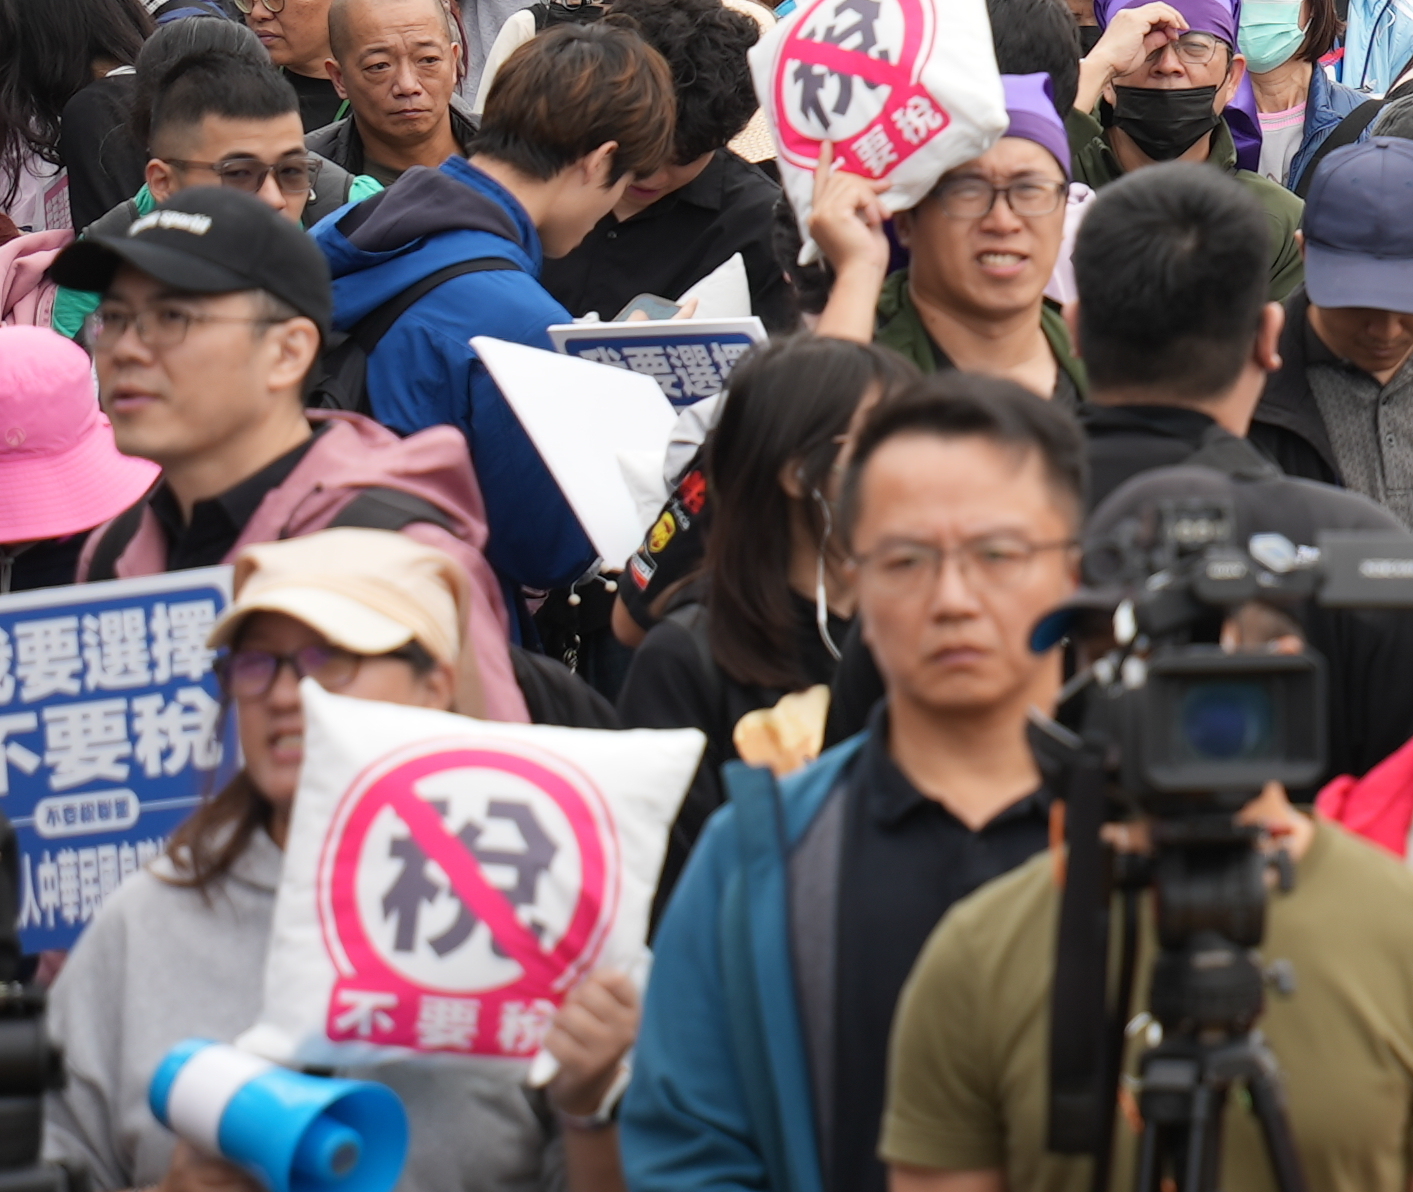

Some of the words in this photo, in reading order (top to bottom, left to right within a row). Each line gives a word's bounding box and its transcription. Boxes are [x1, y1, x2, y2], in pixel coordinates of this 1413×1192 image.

[829, 94, 944, 178] 要稅
[381, 798, 561, 958] 稅
[336, 990, 552, 1057] 不要稅
